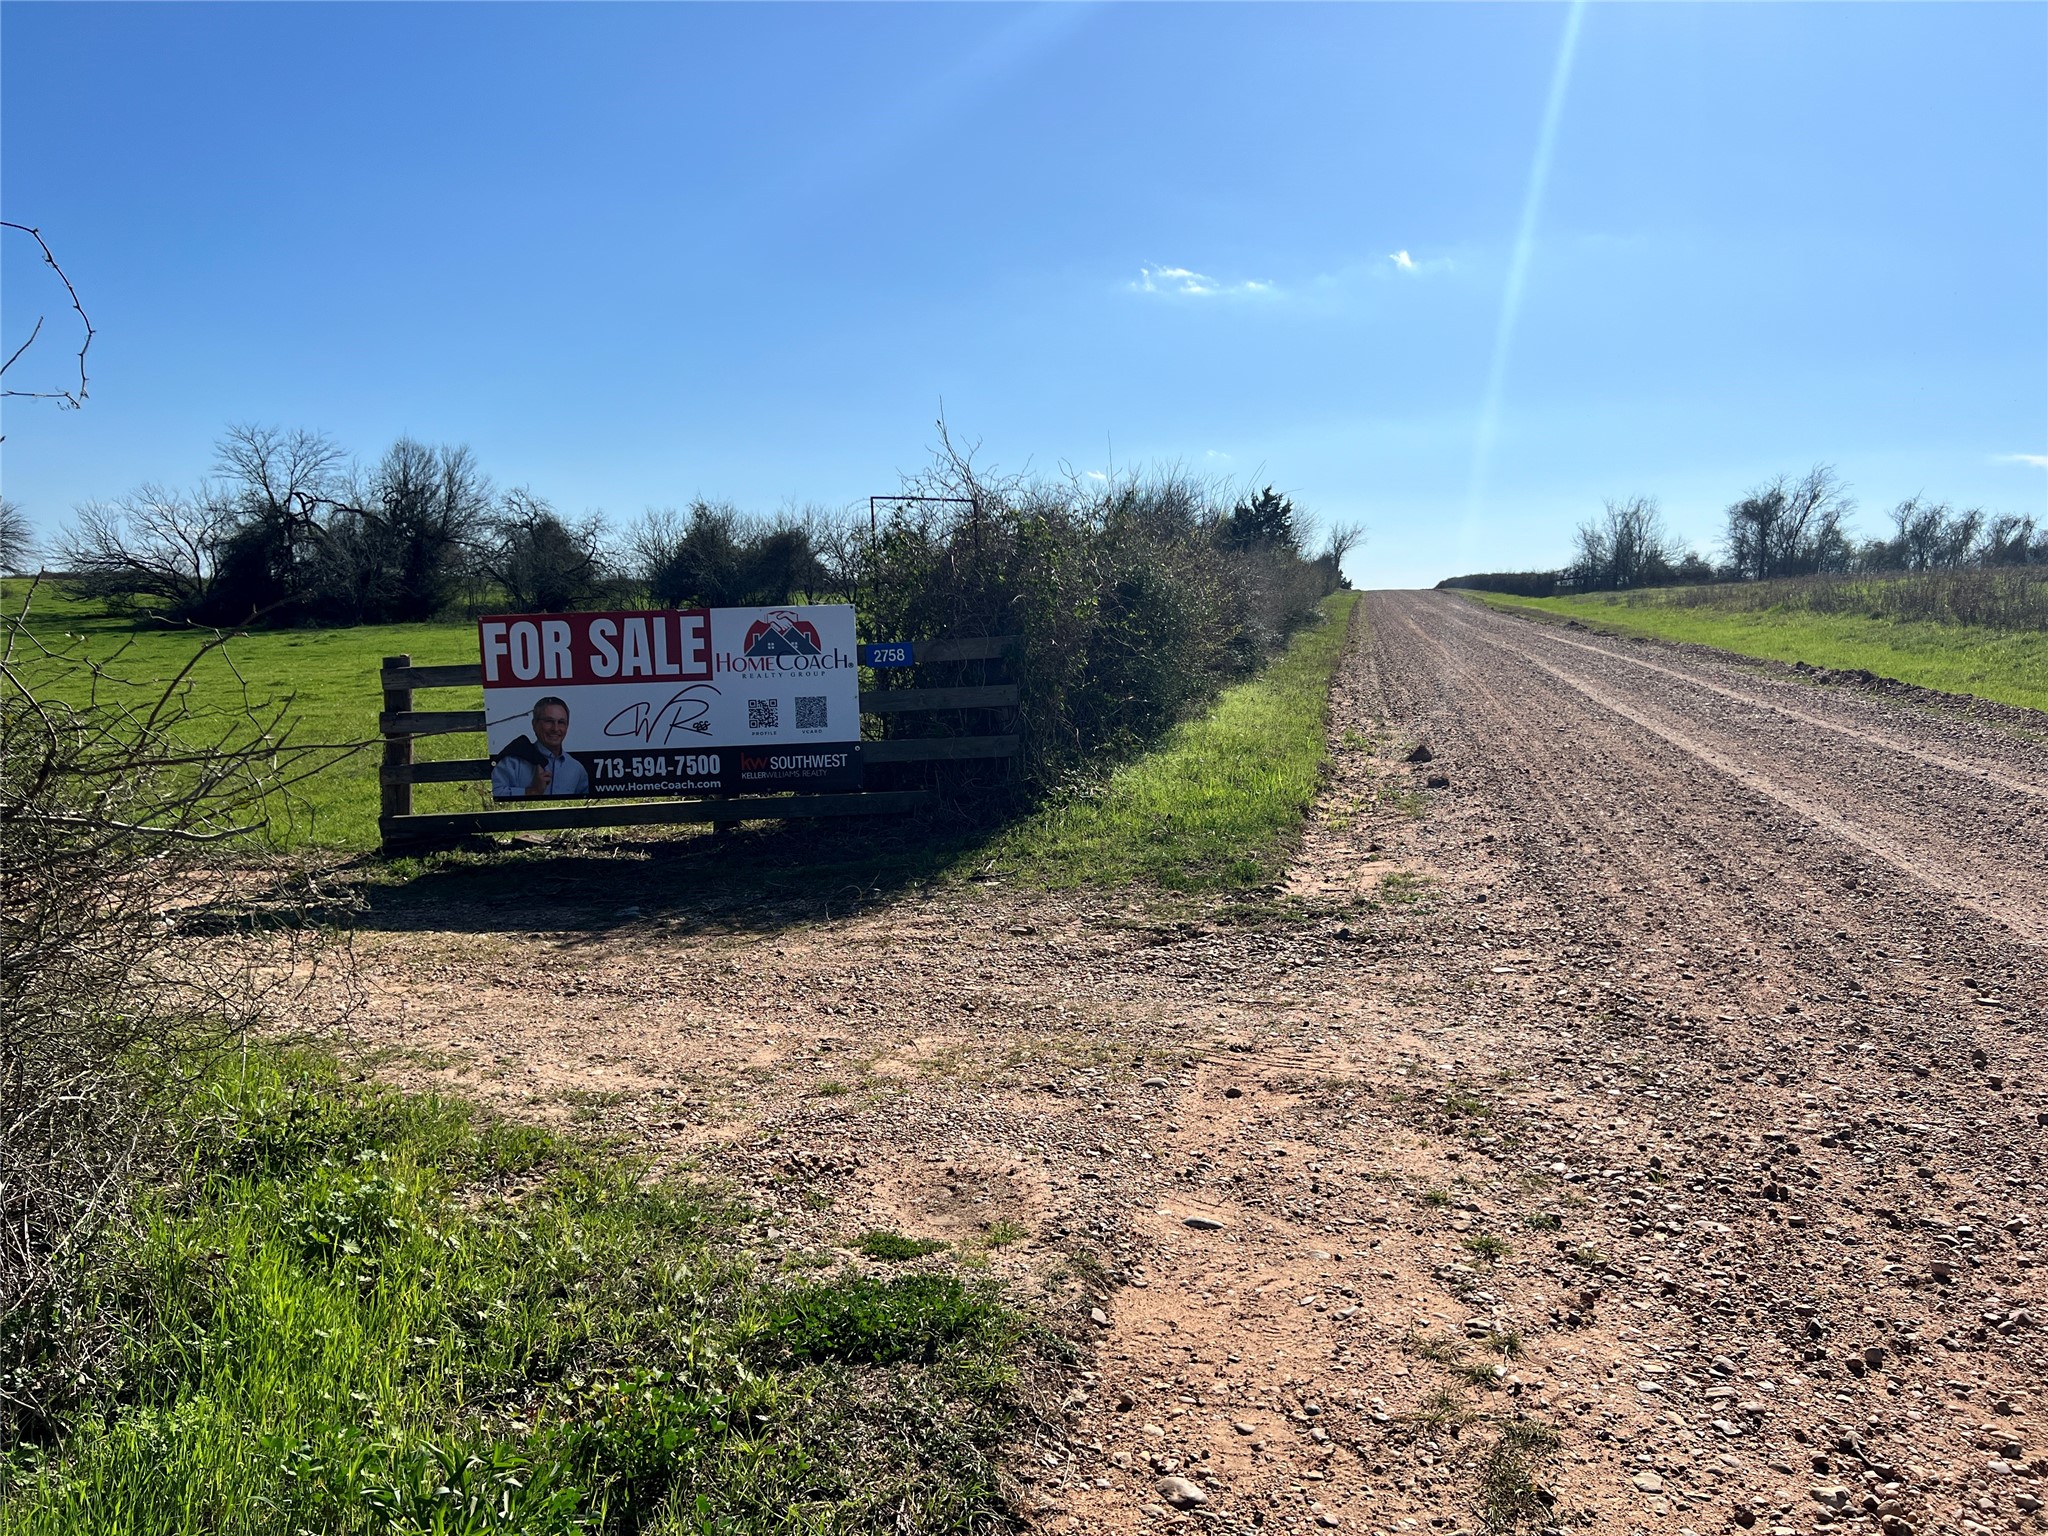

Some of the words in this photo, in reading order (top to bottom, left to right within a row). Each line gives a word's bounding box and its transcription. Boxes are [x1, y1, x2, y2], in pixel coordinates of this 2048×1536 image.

[482, 620, 573, 682] FOR
[588, 615, 707, 678] SALE
[873, 648, 906, 663] 2758
[593, 754, 721, 779] 713-594-7500
[740, 752, 769, 771] kw
[770, 753, 848, 770] SOUTHWEST
[802, 769, 828, 777] REALTY
[595, 779, 721, 793] www.HomeCoach.com
